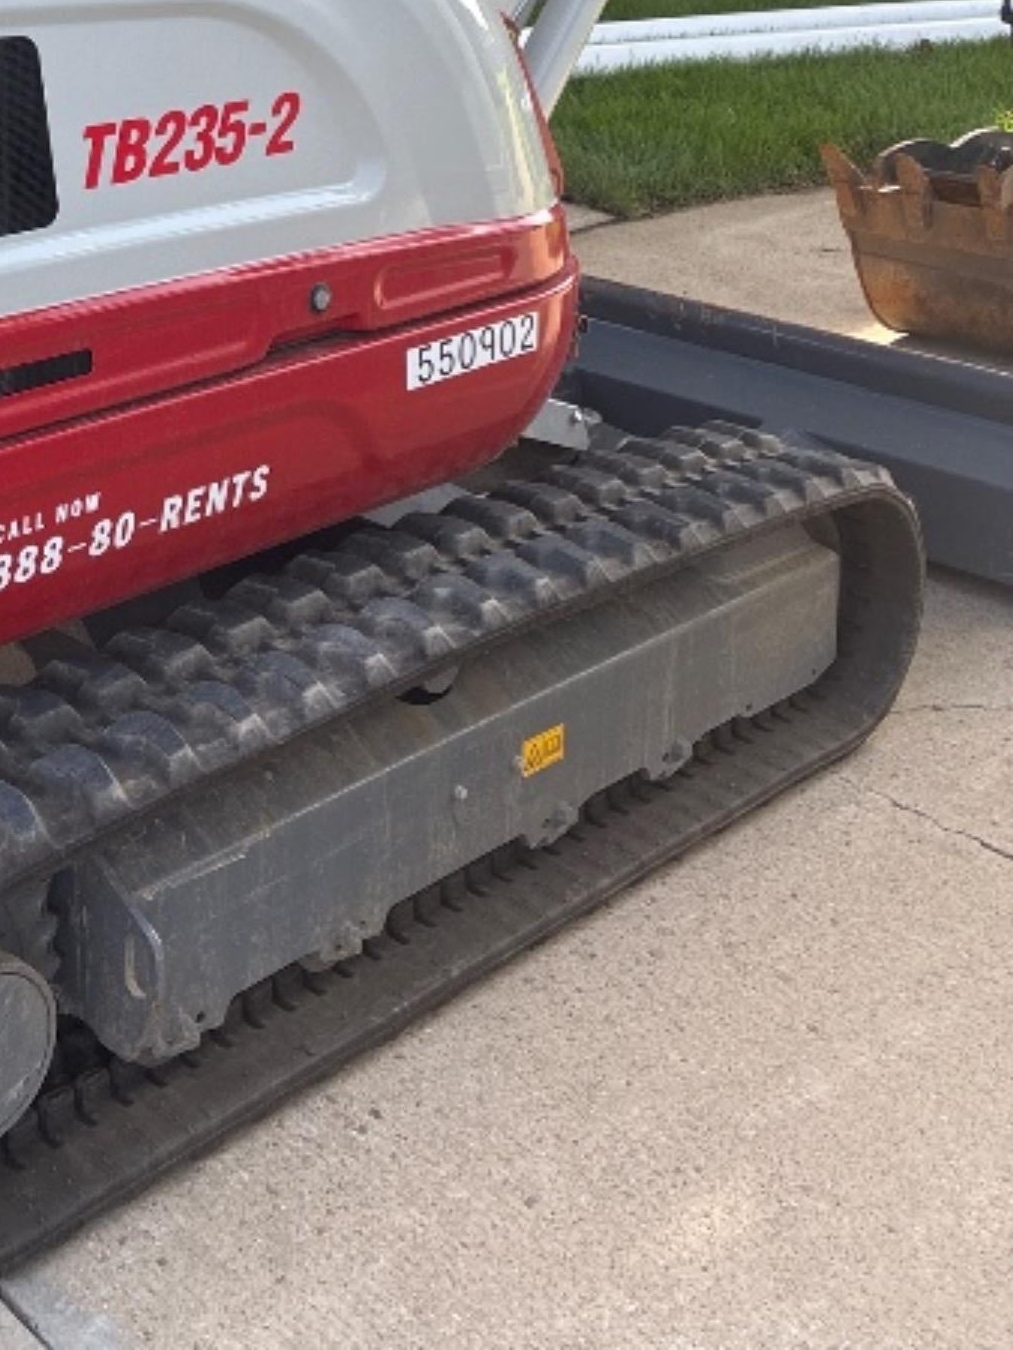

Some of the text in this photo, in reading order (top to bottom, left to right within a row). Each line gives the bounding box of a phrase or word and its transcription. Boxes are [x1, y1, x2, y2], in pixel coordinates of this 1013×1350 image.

[83, 91, 301, 190] TB235-2
[418, 313, 535, 383] 550902
[55, 492, 102, 523] NOW
